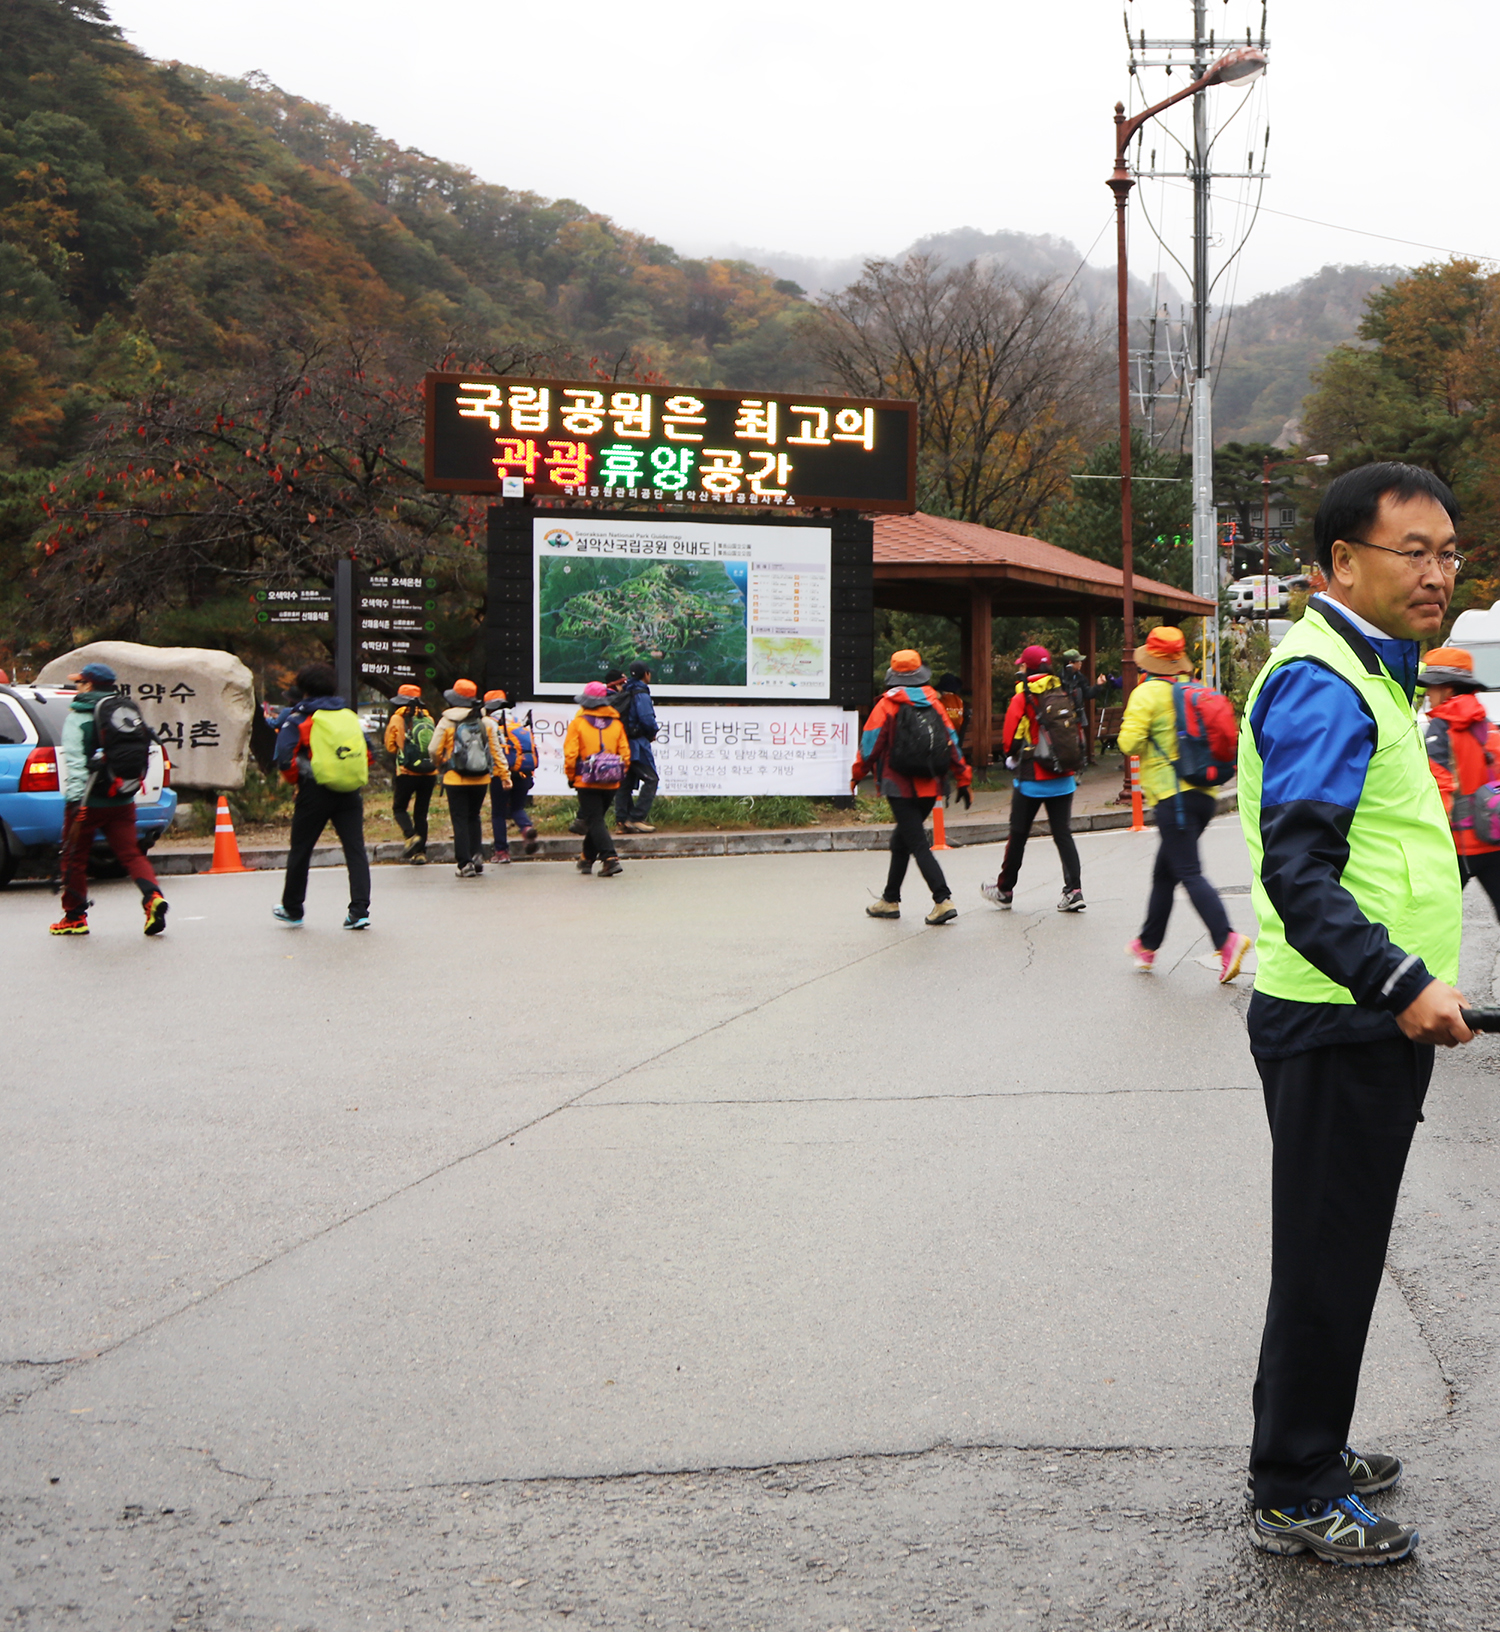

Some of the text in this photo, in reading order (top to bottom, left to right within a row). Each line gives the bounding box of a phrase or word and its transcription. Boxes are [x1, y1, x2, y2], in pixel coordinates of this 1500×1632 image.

[455, 382, 876, 452] 국립공원은 최고의
[564, 486, 796, 506] 국립공원관리공단 설악산국립공원사무소
[576, 537, 667, 555] 설악산국립공원
[673, 540, 711, 556] 안내도
[701, 720, 762, 746] 탐방로
[769, 721, 849, 747] 입산통제
[692, 765, 727, 776] 안전성
[772, 765, 795, 777] 개방
